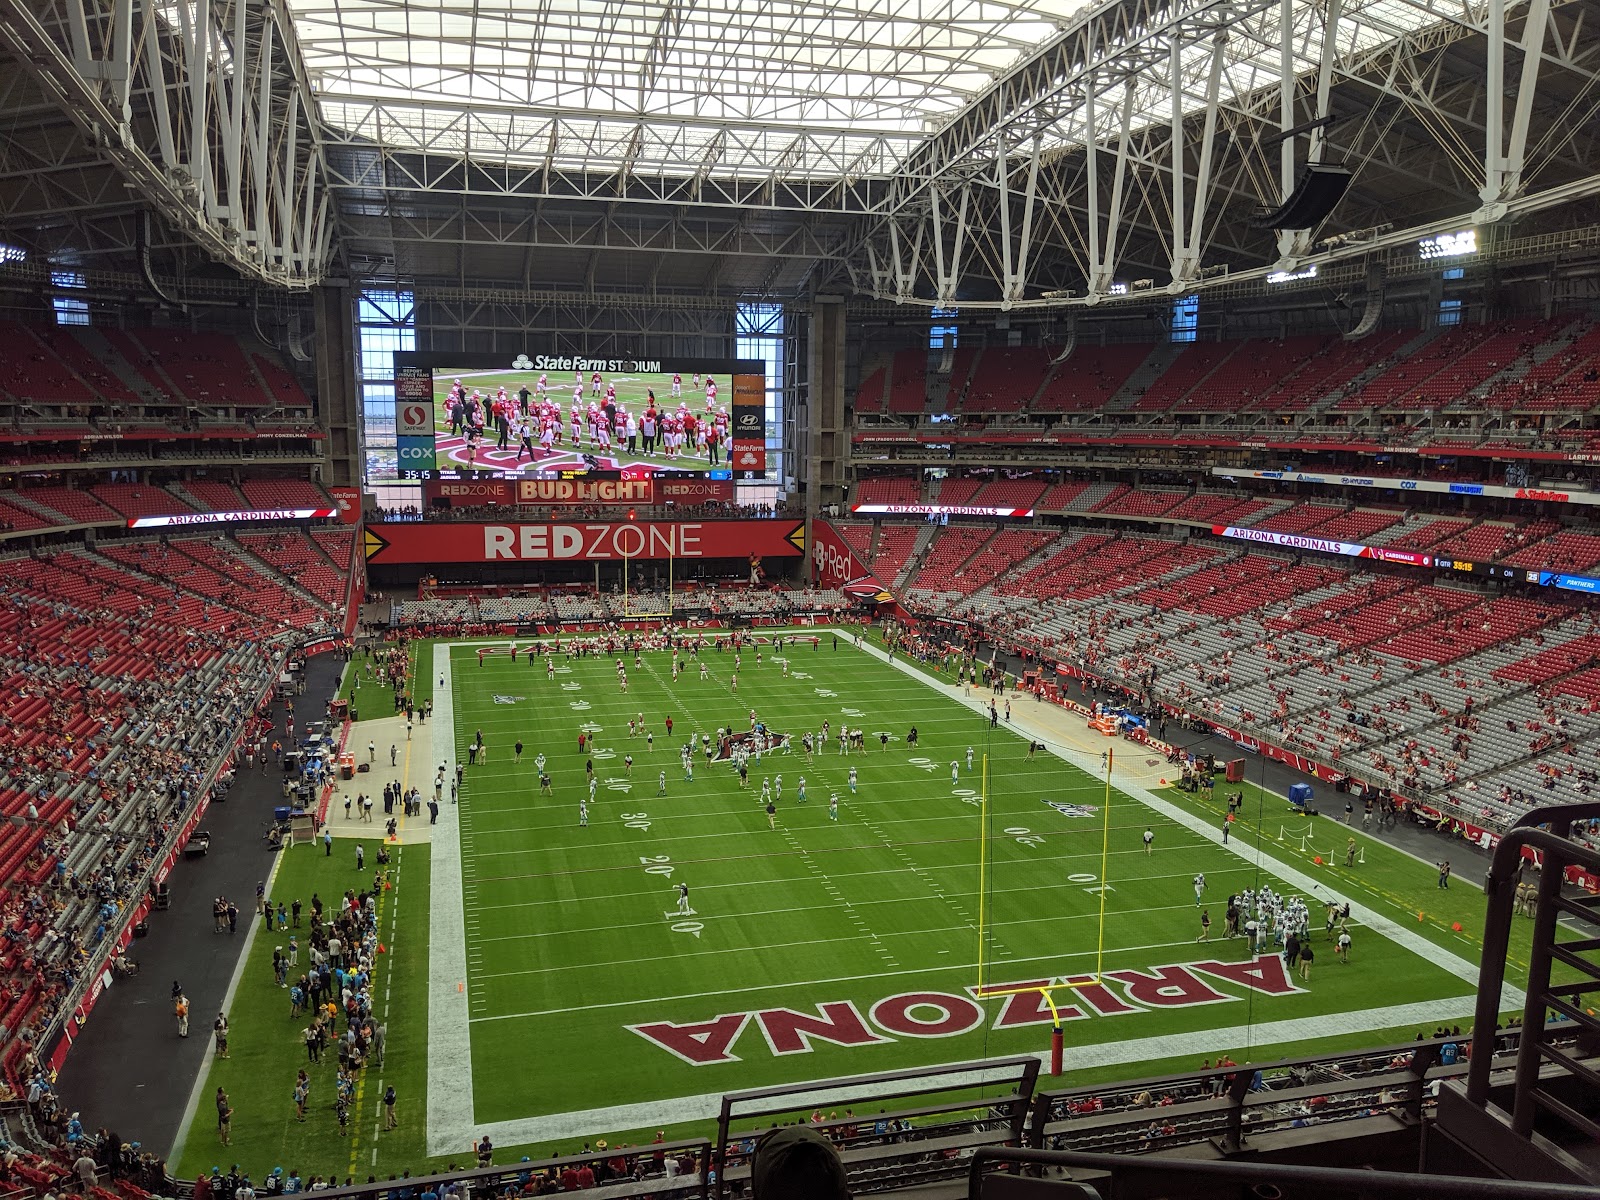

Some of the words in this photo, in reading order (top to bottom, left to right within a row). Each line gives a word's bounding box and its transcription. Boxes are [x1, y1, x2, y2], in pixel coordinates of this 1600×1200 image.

[609, 360, 660, 372] STDIUM
[400, 448, 432, 458] COX
[405, 470, 430, 479] 35:15
[441, 485, 504, 495] REDZONE
[521, 481, 573, 499] BUD
[577, 481, 648, 499] LIGHT
[663, 485, 720, 495] REDZONE
[1400, 481, 1417, 489] COX
[939, 506, 998, 515] CARDINALS
[168, 514, 218, 525] ARIZONA
[224, 510, 296, 522] CARDINALS
[484, 524, 703, 559] REDZONE
[1233, 529, 1274, 543] ARIZONA
[1280, 536, 1341, 552] CARDINALS
[1385, 552, 1414, 561] CARDINALS
[1453, 561, 1472, 571] 35:15
[1566, 580, 1595, 589] PANTHERS
[622, 952, 1311, 1066] ARIZONA
